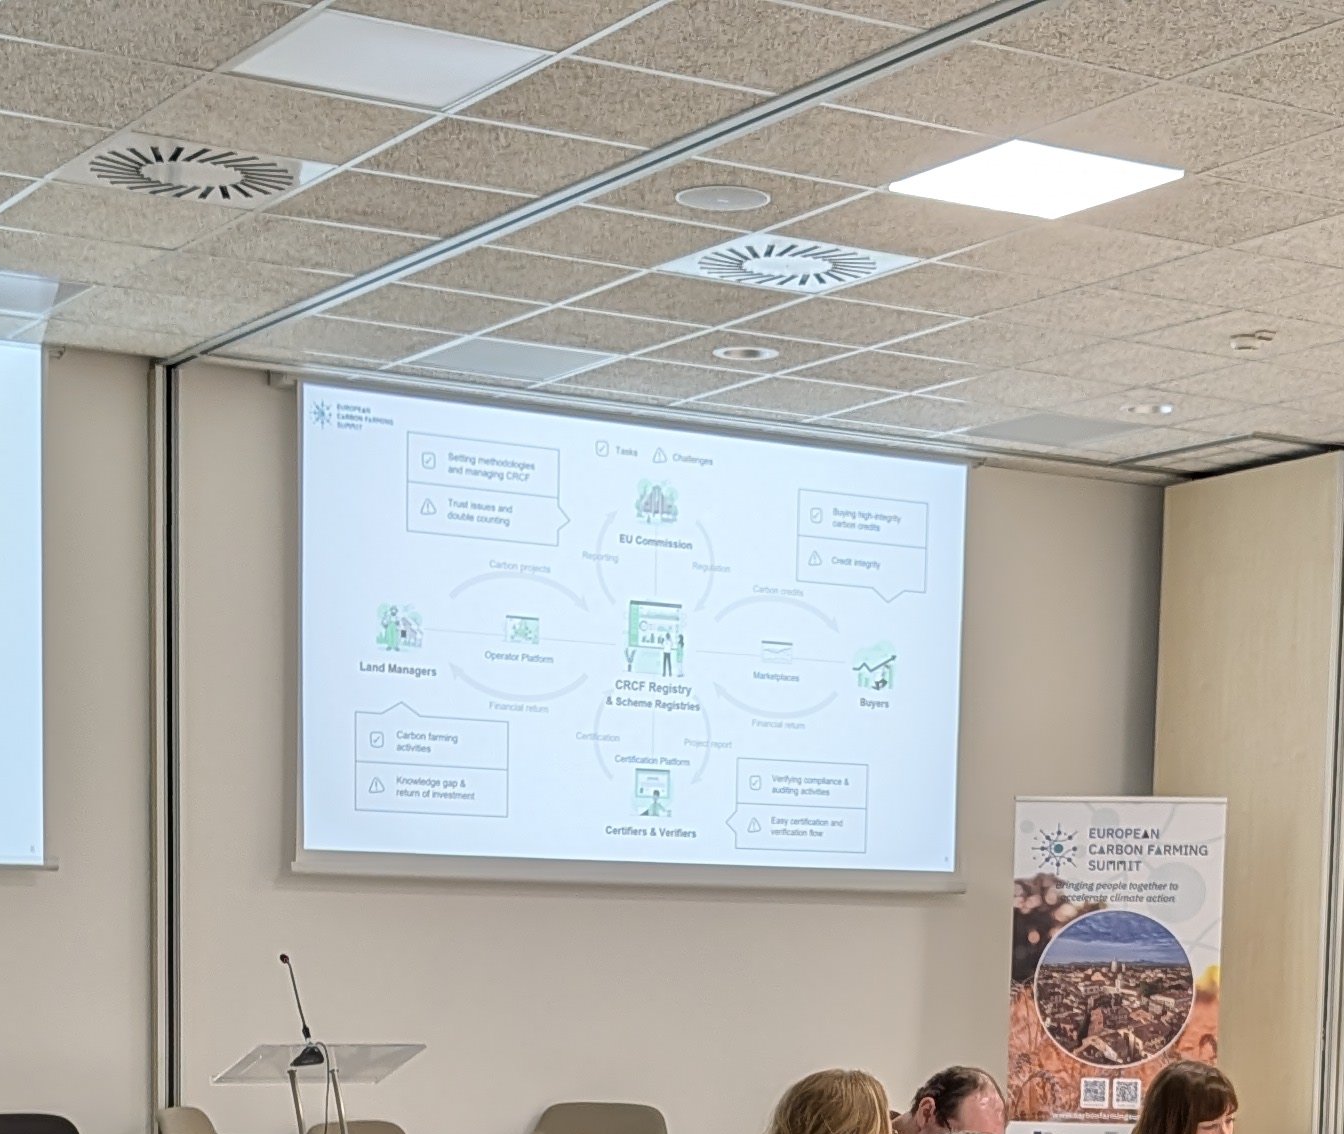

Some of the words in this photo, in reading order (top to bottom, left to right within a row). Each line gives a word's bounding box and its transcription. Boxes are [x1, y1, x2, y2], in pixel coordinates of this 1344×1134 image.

[616, 446, 638, 457] Tasks
[448, 453, 476, 466] Setting
[478, 457, 535, 471] methodologies
[448, 465, 463, 475] and
[465, 467, 504, 481] managing
[448, 499, 467, 509] Trust
[469, 500, 494, 512] issues
[497, 503, 512, 513] and
[447, 511, 474, 522] double
[476, 513, 510, 527] counting
[619, 534, 633, 544] EU
[635, 535, 693, 549] Commission
[485, 650, 519, 662] Operator
[521, 653, 553, 664] Platform
[360, 661, 385, 673] Land
[388, 663, 437, 678] Managers
[615, 680, 645, 691] CRCF
[649, 682, 692, 696] Registry
[616, 696, 652, 709] Scheme
[655, 699, 700, 712] Registries
[860, 698, 889, 709] Buyers
[396, 730, 425, 741] Carbon
[428, 732, 458, 744] farming
[615, 755, 657, 765] Certification
[660, 757, 690, 766] Platform
[396, 776, 440, 789] Knowledge
[443, 778, 457, 790] gap
[460, 779, 465, 787] &
[422, 789, 430, 798] of
[432, 789, 474, 801] investment
[606, 825, 647, 836] Certifiers
[650, 827, 656, 836] &
[659, 827, 696, 839] Verifiers
[1088, 828, 1159, 839] EUROPEAN
[1088, 844, 1143, 855] CARBON
[1148, 845, 1208, 856] FARMING
[1088, 860, 1142, 871] SUMMIT
[1055, 881, 1094, 892] Bringing
[1096, 882, 1126, 892] people
[1129, 882, 1167, 892] together
[1169, 883, 1178, 891] to
[1060, 894, 1108, 903] accelerate
[1109, 894, 1144, 903] climate
[1146, 894, 1175, 903] action
